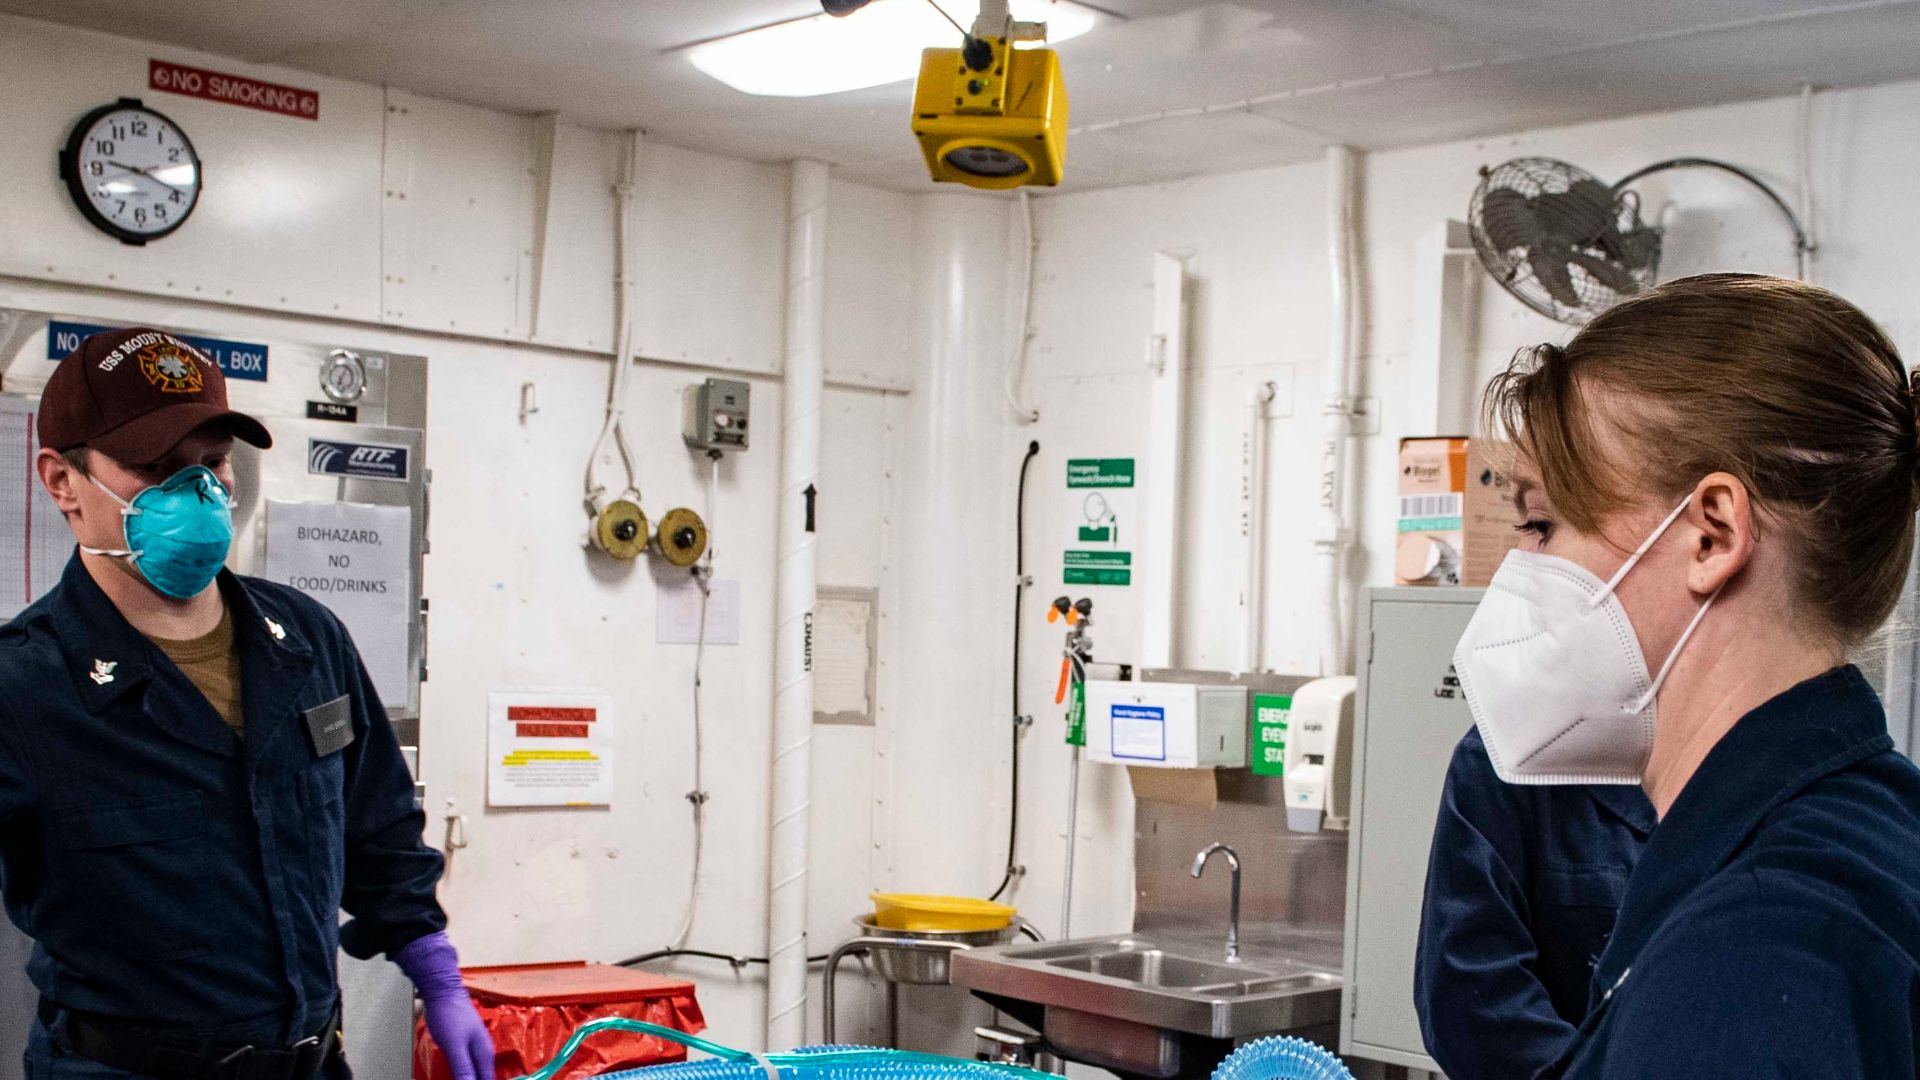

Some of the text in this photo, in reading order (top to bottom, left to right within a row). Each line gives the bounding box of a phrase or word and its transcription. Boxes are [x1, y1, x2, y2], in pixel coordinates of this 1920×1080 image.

[172, 70, 298, 112] NO SMOKING
[112, 125, 125, 140] 11
[131, 121, 147, 137] 12
[96, 140, 115, 156] 10
[168, 147, 179, 162] 2
[90, 161, 103, 176] 9
[115, 199, 126, 214] 7
[154, 203, 166, 218] 5
[134, 207, 147, 224] 6
[56, 331, 79, 352] NO
[97, 347, 124, 373] USS
[124, 332, 163, 356] MOUNT
[230, 350, 263, 373] BOX
[349, 446, 397, 462] RTF
[297, 526, 383, 547] BIOHAZARD,
[328, 554, 351, 569] NO
[289, 576, 388, 594] FOOD/DRINKS
